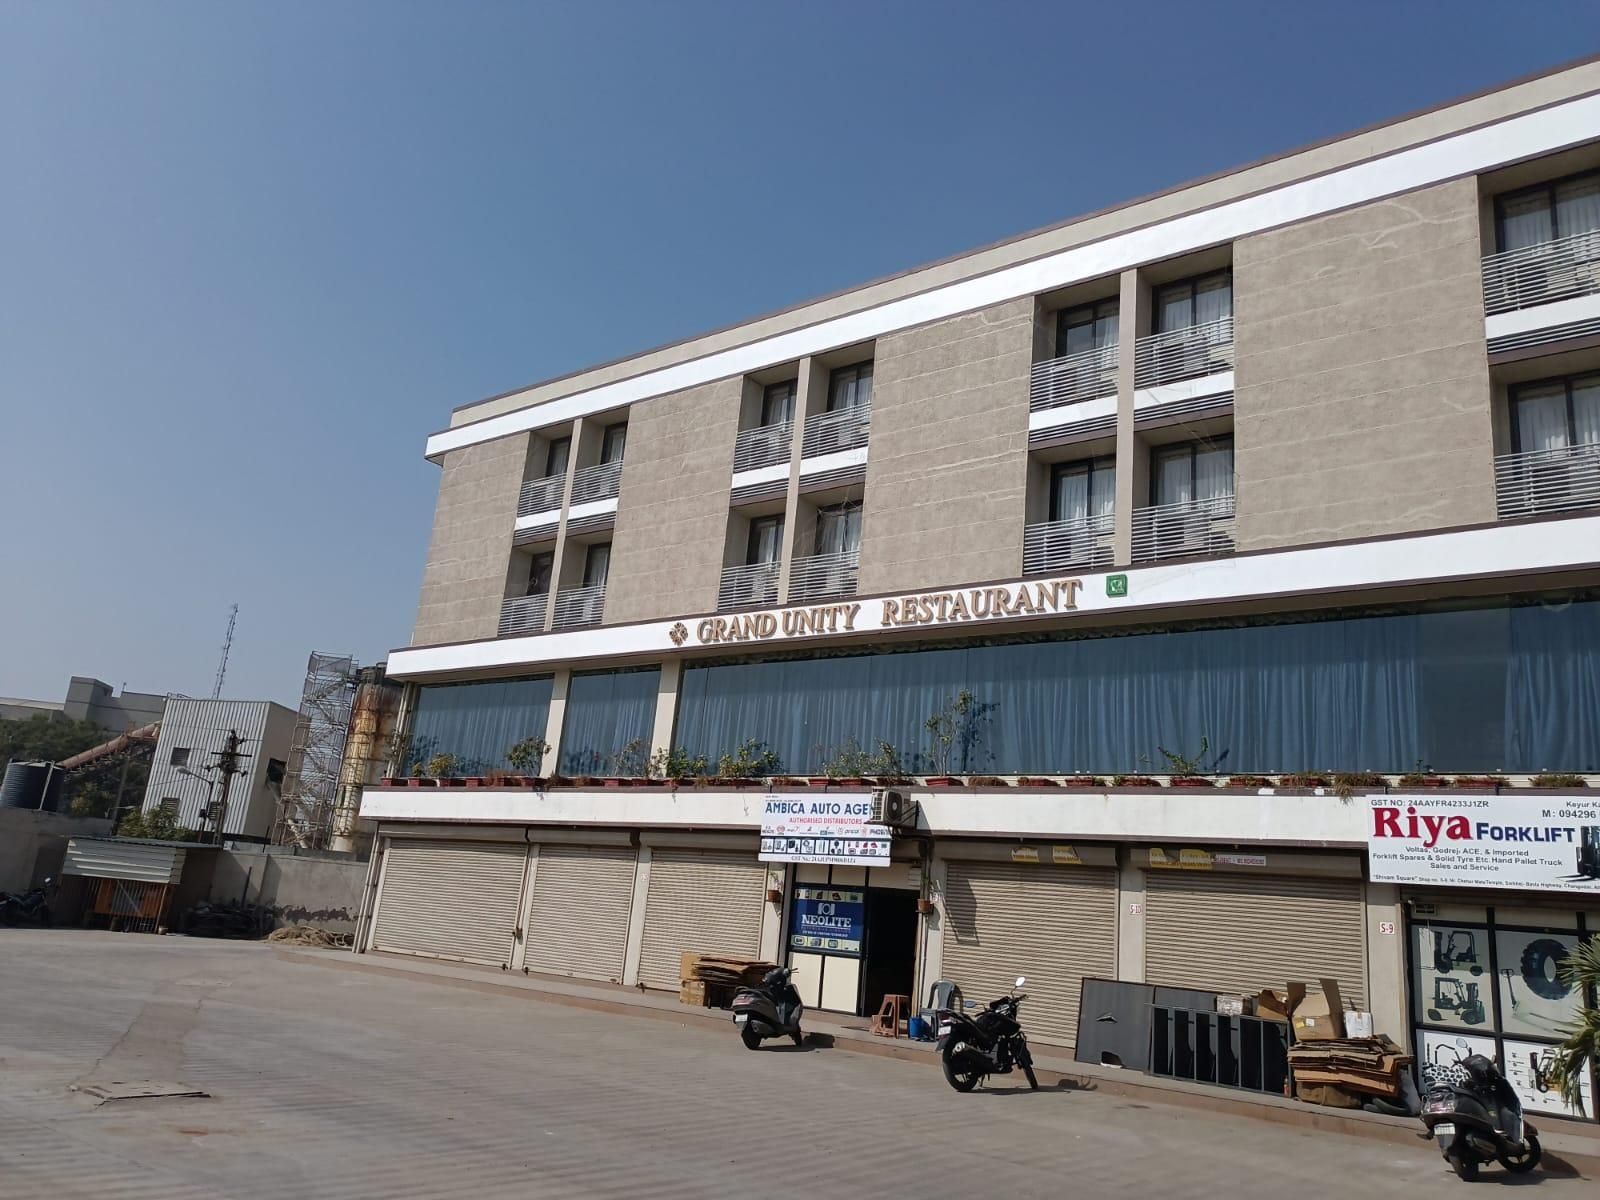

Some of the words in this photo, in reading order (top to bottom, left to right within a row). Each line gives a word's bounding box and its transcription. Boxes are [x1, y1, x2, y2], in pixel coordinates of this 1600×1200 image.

[696, 612, 777, 645] GRAND
[781, 602, 862, 635] UNITY
[880, 578, 1084, 628] RESTAURANT
[765, 802, 805, 815] AMBICA
[810, 803, 841, 815] AUTO
[1559, 809, 1597, 819] 094296
[824, 817, 863, 825] DISTRIBUTORS
[1372, 806, 1474, 848] Riya
[1476, 822, 1576, 843] FORKLIFT
[1493, 848, 1529, 857] Imported
[1372, 853, 1398, 861] Forklift
[1400, 853, 1426, 862] Spares
[1435, 854, 1455, 862] Solid
[1457, 855, 1474, 864] Tyre
[1514, 857, 1538, 865] Pallet
[1540, 858, 1563, 866] Truck
[1430, 862, 1452, 870] Sales
[1469, 864, 1499, 872] Service
[801, 914, 852, 928] NEOLITE
[1381, 923, 1394, 934] S-9
